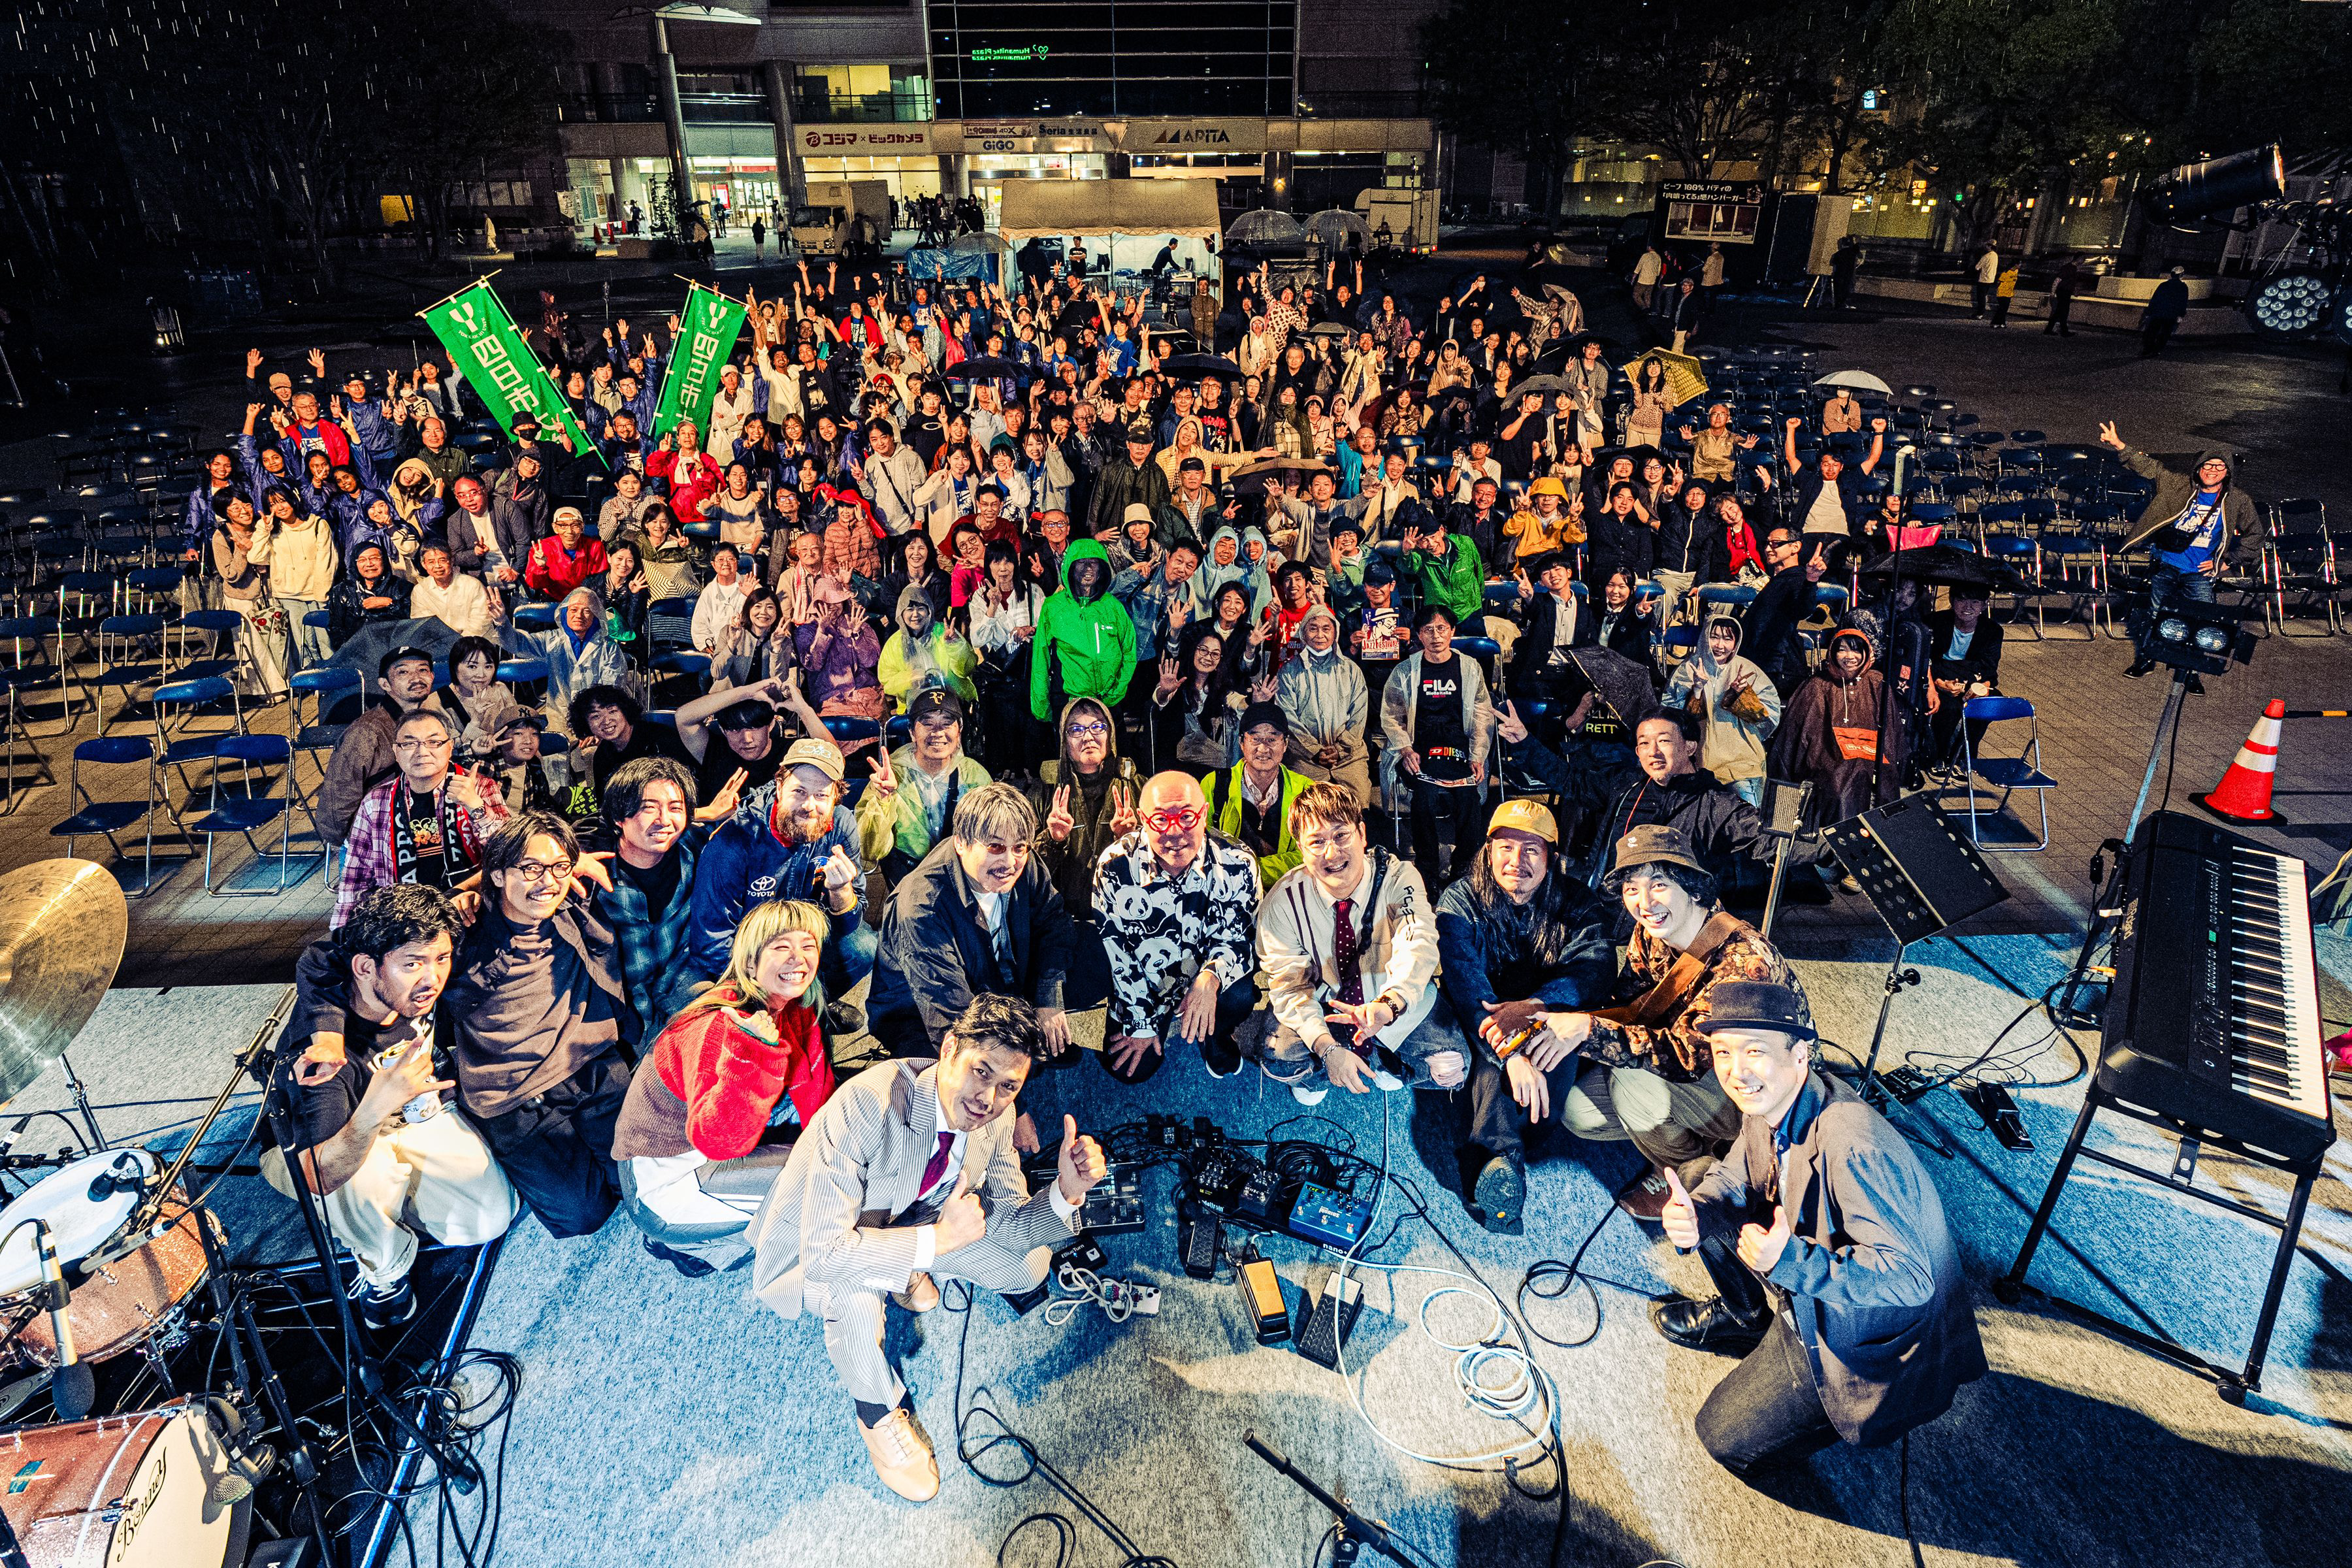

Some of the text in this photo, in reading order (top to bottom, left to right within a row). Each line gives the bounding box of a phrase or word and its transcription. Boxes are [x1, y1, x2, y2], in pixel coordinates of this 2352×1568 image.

[1039, 124, 1066, 135] Seria
[1183, 129, 1230, 142] APITA
[983, 140, 1015, 150] GiGO
[1423, 679, 1457, 691] FILA
[1586, 723, 1619, 734] RETT
[2124, 907, 2137, 940] Roland
